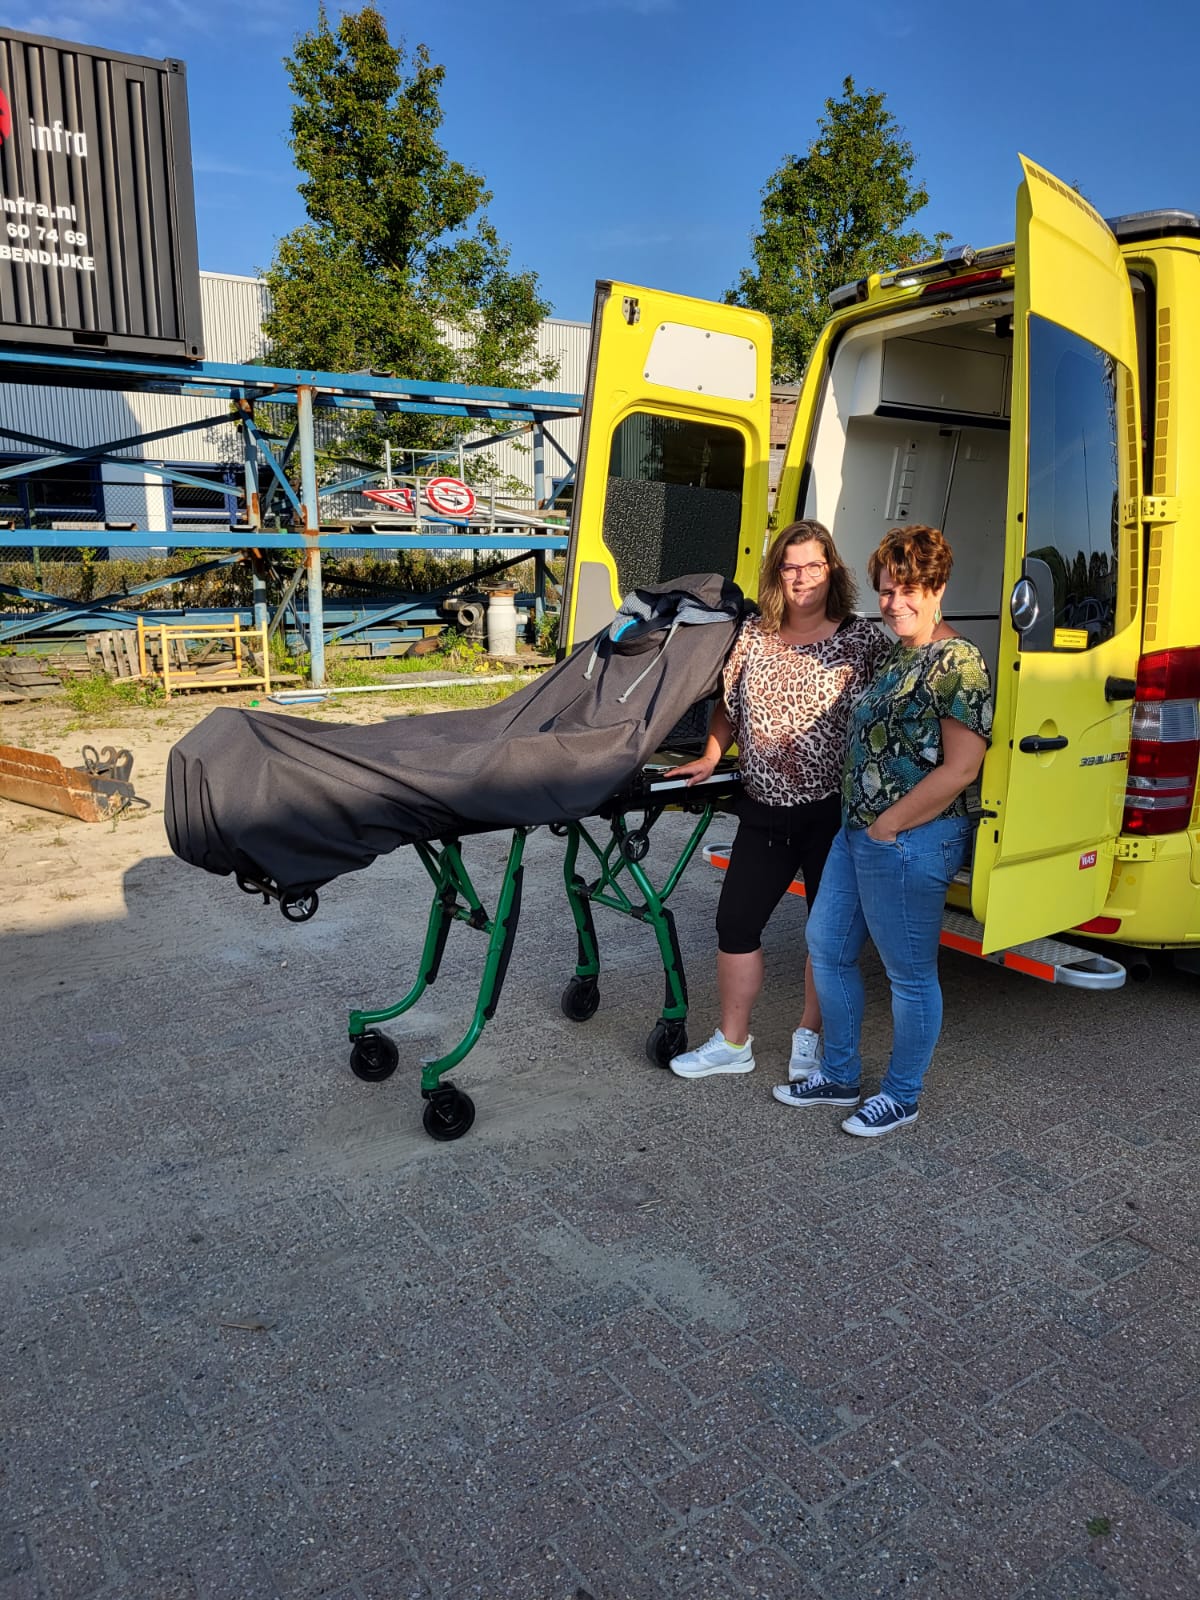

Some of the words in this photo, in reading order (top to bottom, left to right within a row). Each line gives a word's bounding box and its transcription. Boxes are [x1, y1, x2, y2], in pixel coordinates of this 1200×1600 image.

[29, 118, 88, 157] infra
[6, 222, 31, 239] 60
[35, 226, 59, 243] 74
[64, 229, 88, 247] 69
